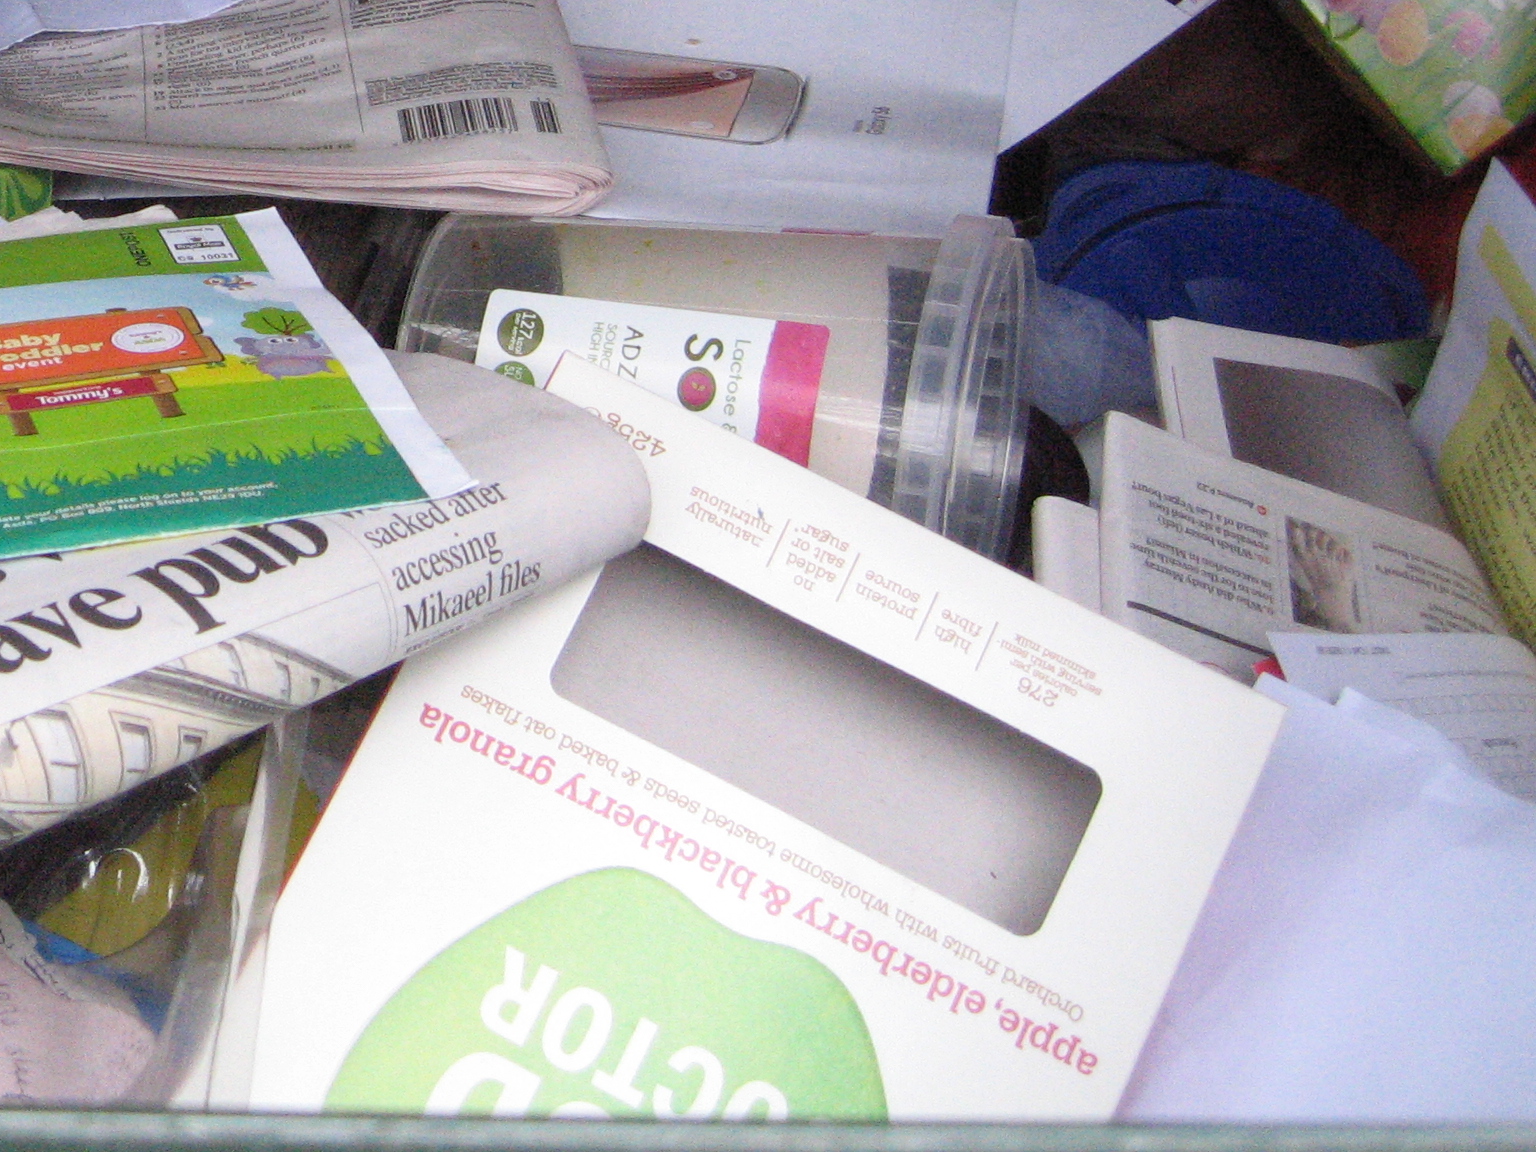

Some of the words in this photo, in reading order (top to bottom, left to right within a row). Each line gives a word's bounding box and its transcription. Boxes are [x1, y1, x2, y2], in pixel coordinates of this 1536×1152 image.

[520, 311, 537, 340] 127
[1, 356, 64, 371] event
[598, 322, 618, 370] SOURC
[616, 324, 645, 379] ADZ
[34, 385, 124, 406] Tommy's
[722, 338, 752, 417] Lactose
[54, 503, 96, 516] details
[98, 496, 137, 509] please
[448, 481, 510, 518] after
[690, 485, 773, 536] nutritious
[364, 501, 451, 549] sacked
[685, 500, 762, 548] naturally
[790, 536, 810, 550] or
[133, 515, 330, 634] pub
[391, 530, 504, 591] accessing
[785, 551, 837, 584] added
[815, 545, 846, 570] salt
[403, 570, 495, 637] Mikaeel
[499, 559, 542, 596] files
[793, 575, 816, 593] no
[855, 581, 917, 622] protein
[864, 568, 921, 603] source
[934, 624, 972, 655] high
[941, 607, 983, 637] fibre
[1014, 633, 1042, 652] milk
[1033, 668, 1079, 698] calories
[1042, 648, 1096, 680] skimmed
[1057, 667, 1103, 697] serving
[460, 684, 523, 726] flakes
[1017, 676, 1059, 708] 276
[418, 702, 557, 786] granola
[524, 714, 557, 741] oat
[558, 732, 620, 778] baked
[620, 765, 642, 787] &
[643, 776, 701, 814] seeds
[554, 771, 758, 901] blackberry
[702, 806, 777, 859] toasted
[759, 877, 792, 917] &
[779, 849, 891, 917] wholesome
[893, 907, 939, 944] with
[793, 895, 987, 1016] elderberry
[942, 934, 1001, 977] fruits
[1001, 965, 1085, 1023] Orchard
[477, 945, 790, 1116] OCTOR
[993, 996, 1099, 1076] apple,
